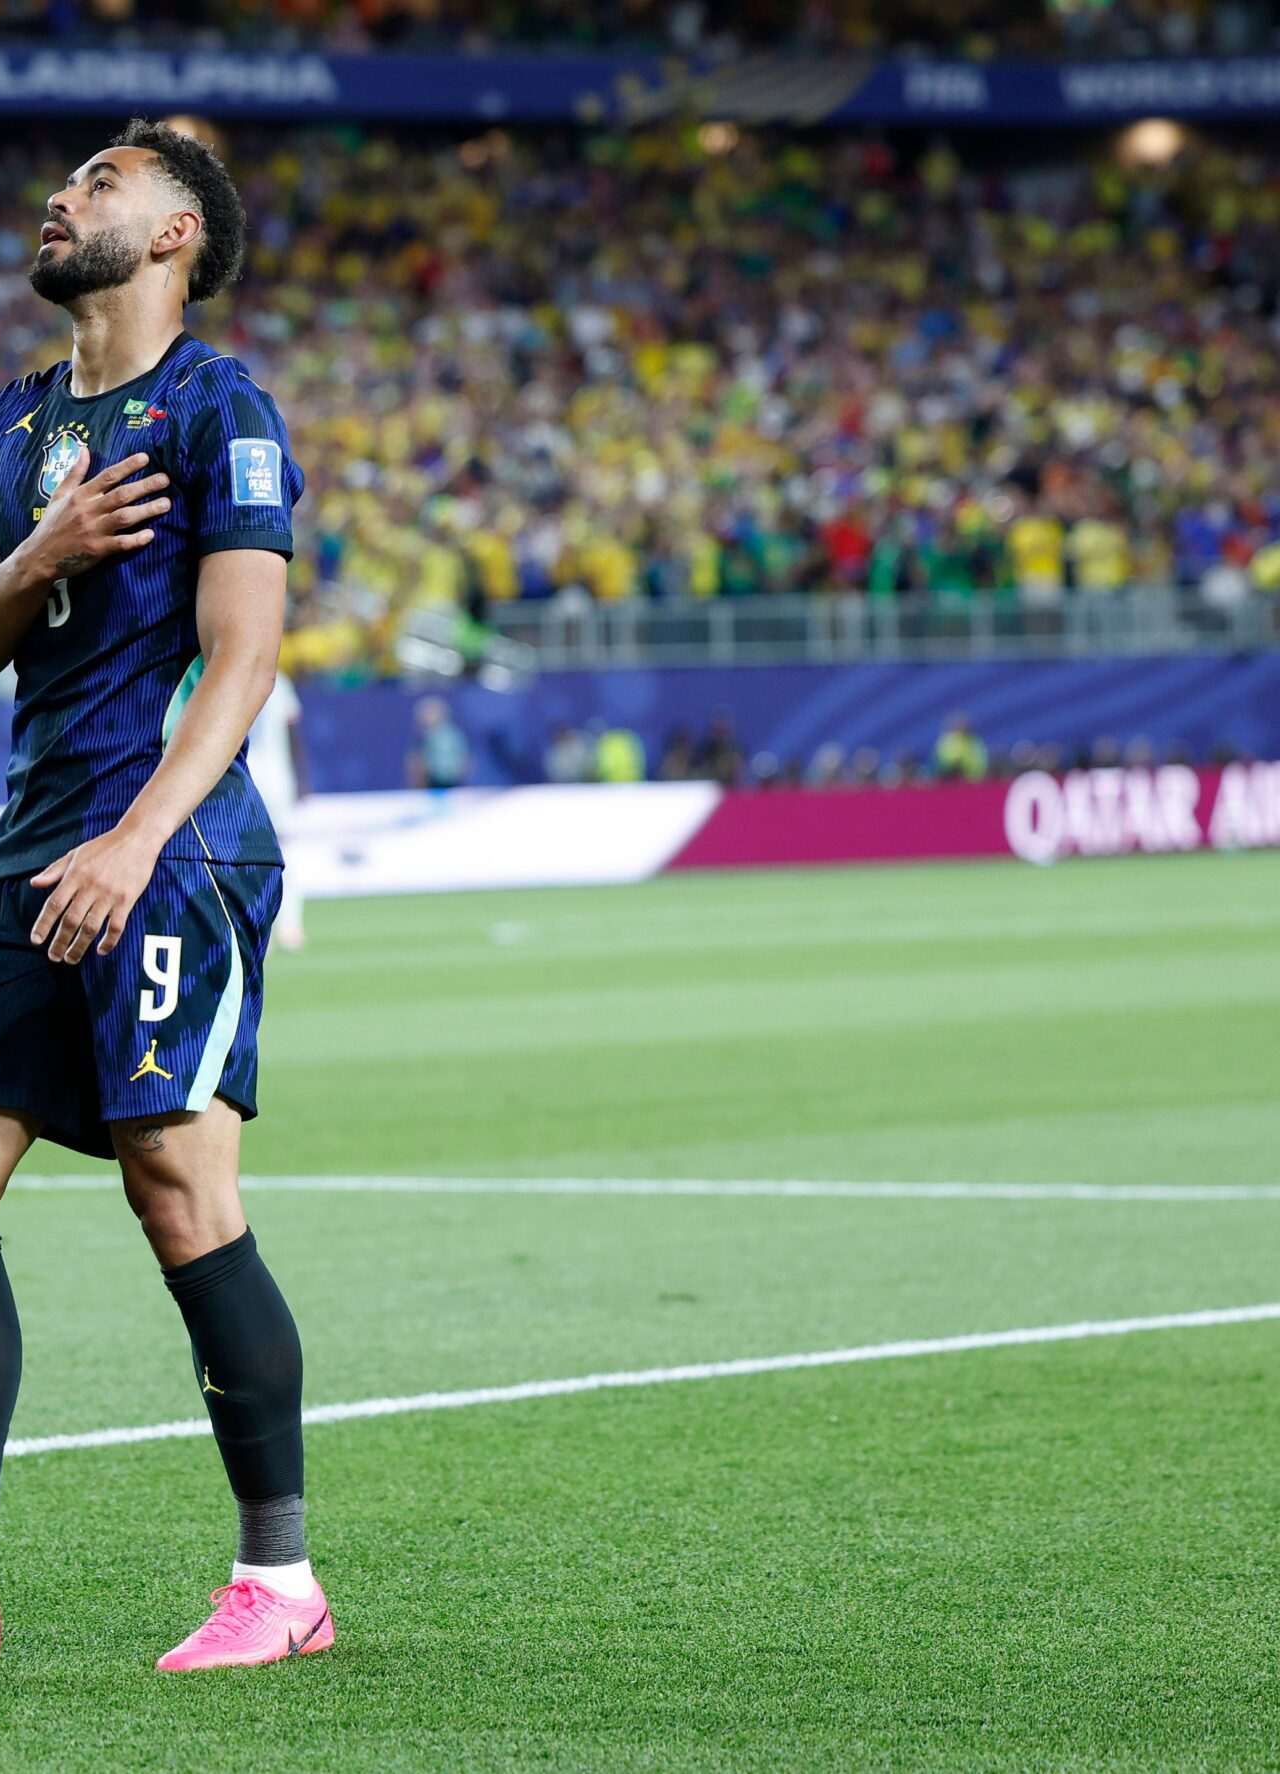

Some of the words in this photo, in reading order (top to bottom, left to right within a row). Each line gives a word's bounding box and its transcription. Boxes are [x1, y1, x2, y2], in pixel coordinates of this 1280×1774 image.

[248, 478, 273, 491] PEACE
[1005, 764, 1202, 866] QATAR
[139, 934, 182, 1022] 9
